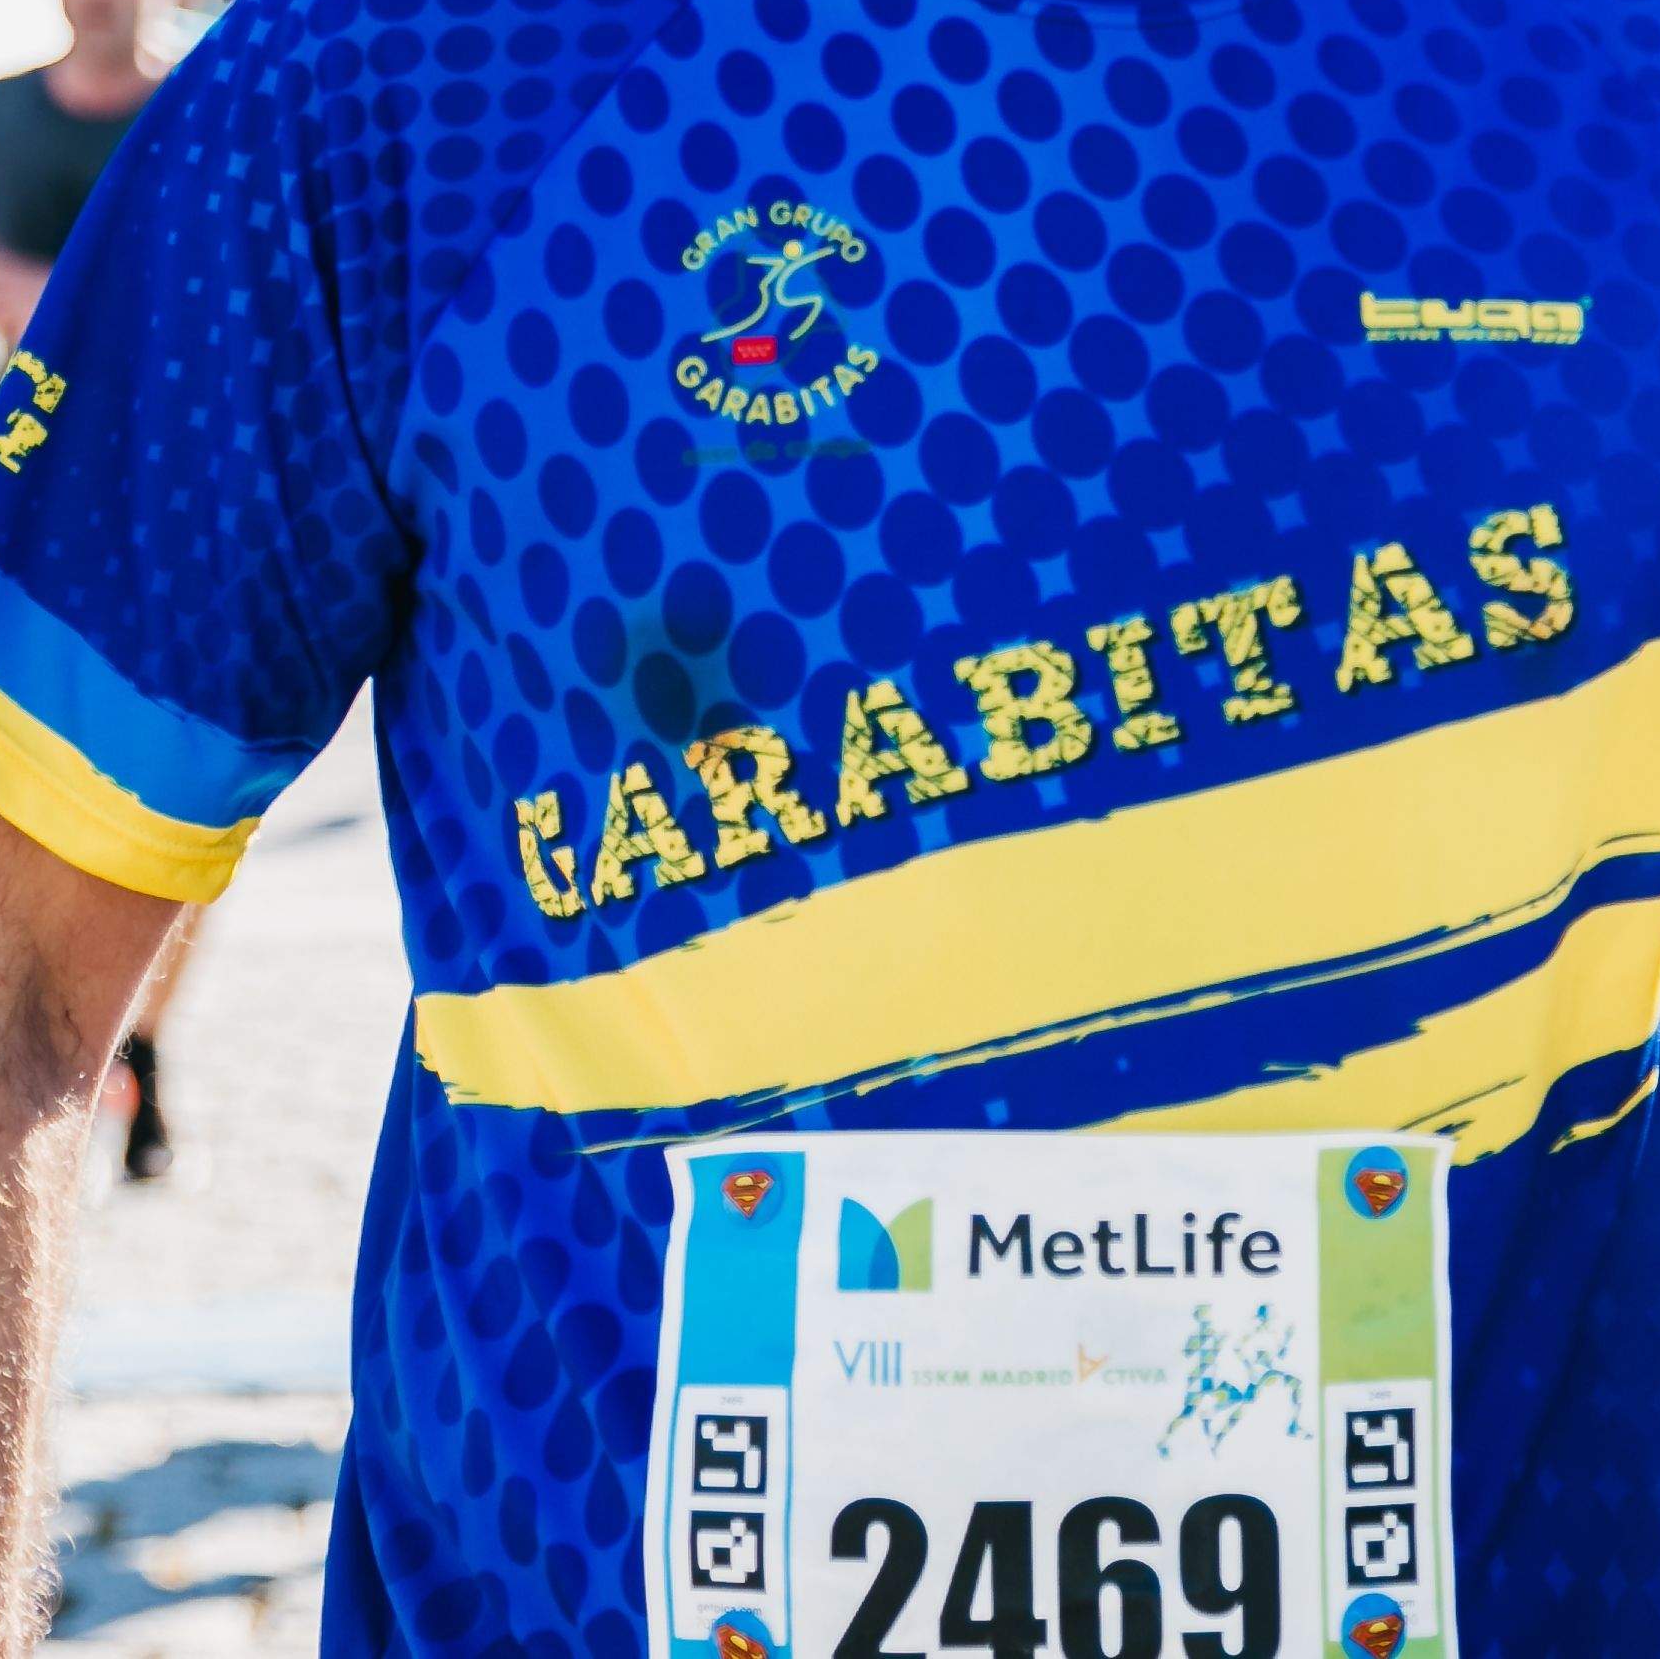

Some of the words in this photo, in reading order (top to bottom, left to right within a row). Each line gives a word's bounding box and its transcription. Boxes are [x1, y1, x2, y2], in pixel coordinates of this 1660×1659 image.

[681, 206, 760, 271] GRAN
[769, 199, 868, 264] GRUPO
[675, 343, 879, 426] GARABITAS
[515, 503, 1575, 919] GARABITAS
[968, 1211, 1283, 1278] MetLife
[833, 1341, 902, 1387] VIII
[979, 1369, 1074, 1386] MADRID
[831, 1493, 1281, 1659] 2469
